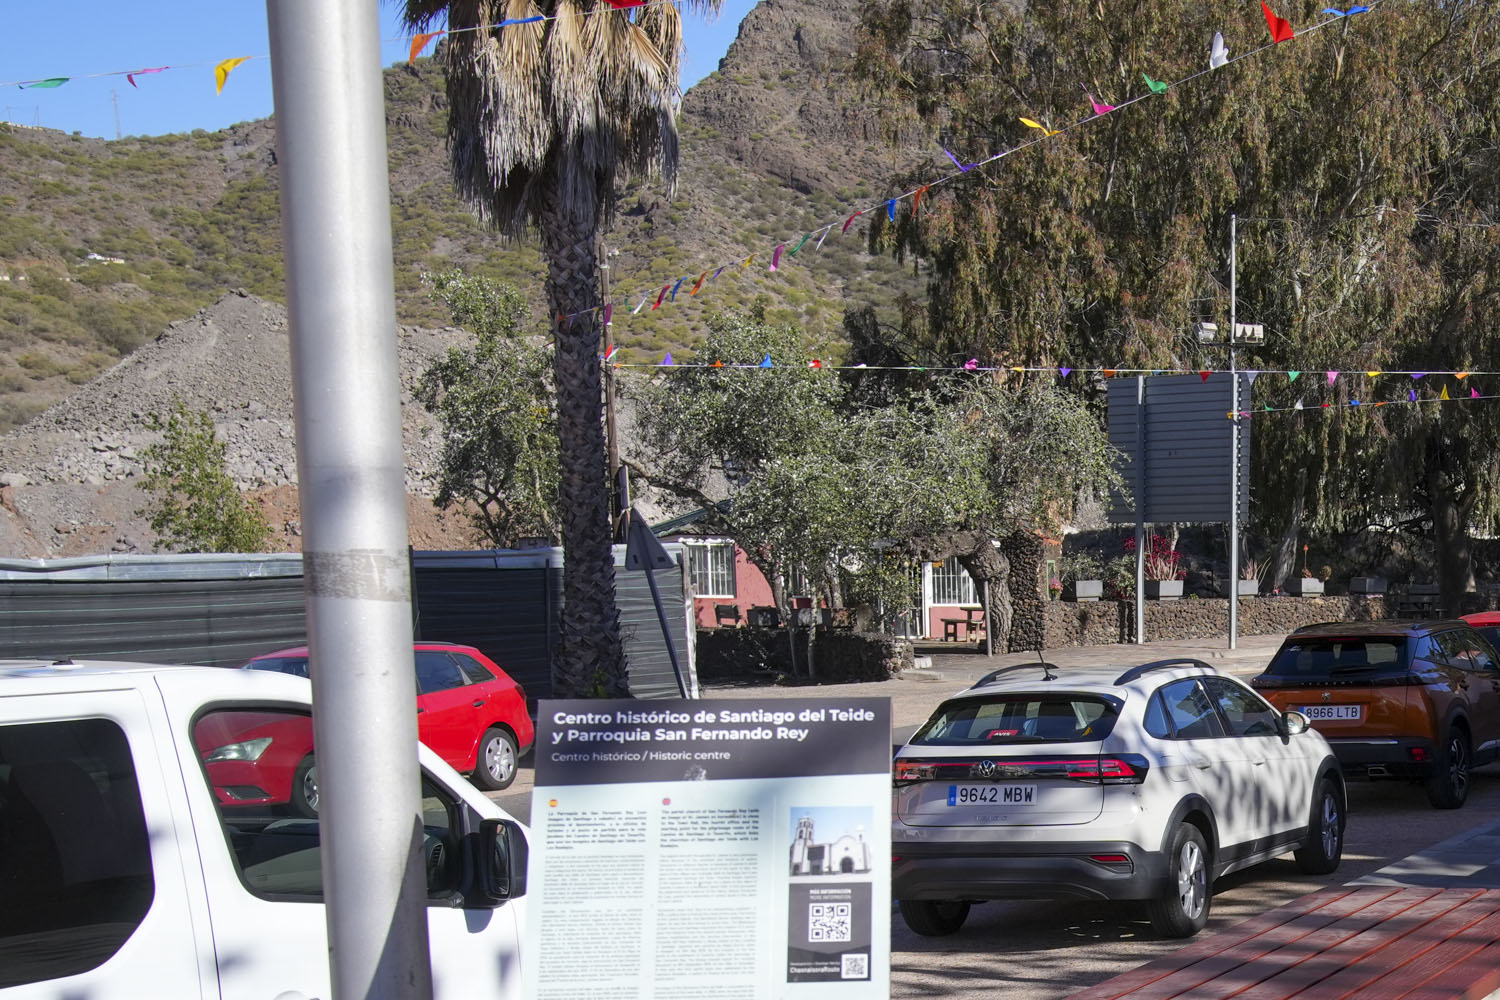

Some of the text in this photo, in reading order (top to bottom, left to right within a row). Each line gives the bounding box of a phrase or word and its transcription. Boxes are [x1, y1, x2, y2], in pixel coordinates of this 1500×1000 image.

[553, 708, 875, 725] Centro histórico de Santiago del Teide
[1306, 707, 1358, 718] 8966 LTB
[552, 727, 808, 744] y Parroquia San Fernando Rey
[551, 752, 590, 762] Centro
[592, 751, 641, 762] histórico
[650, 750, 692, 761] Historic
[694, 751, 731, 760] centre
[960, 787, 1033, 802] 9642 MBW
